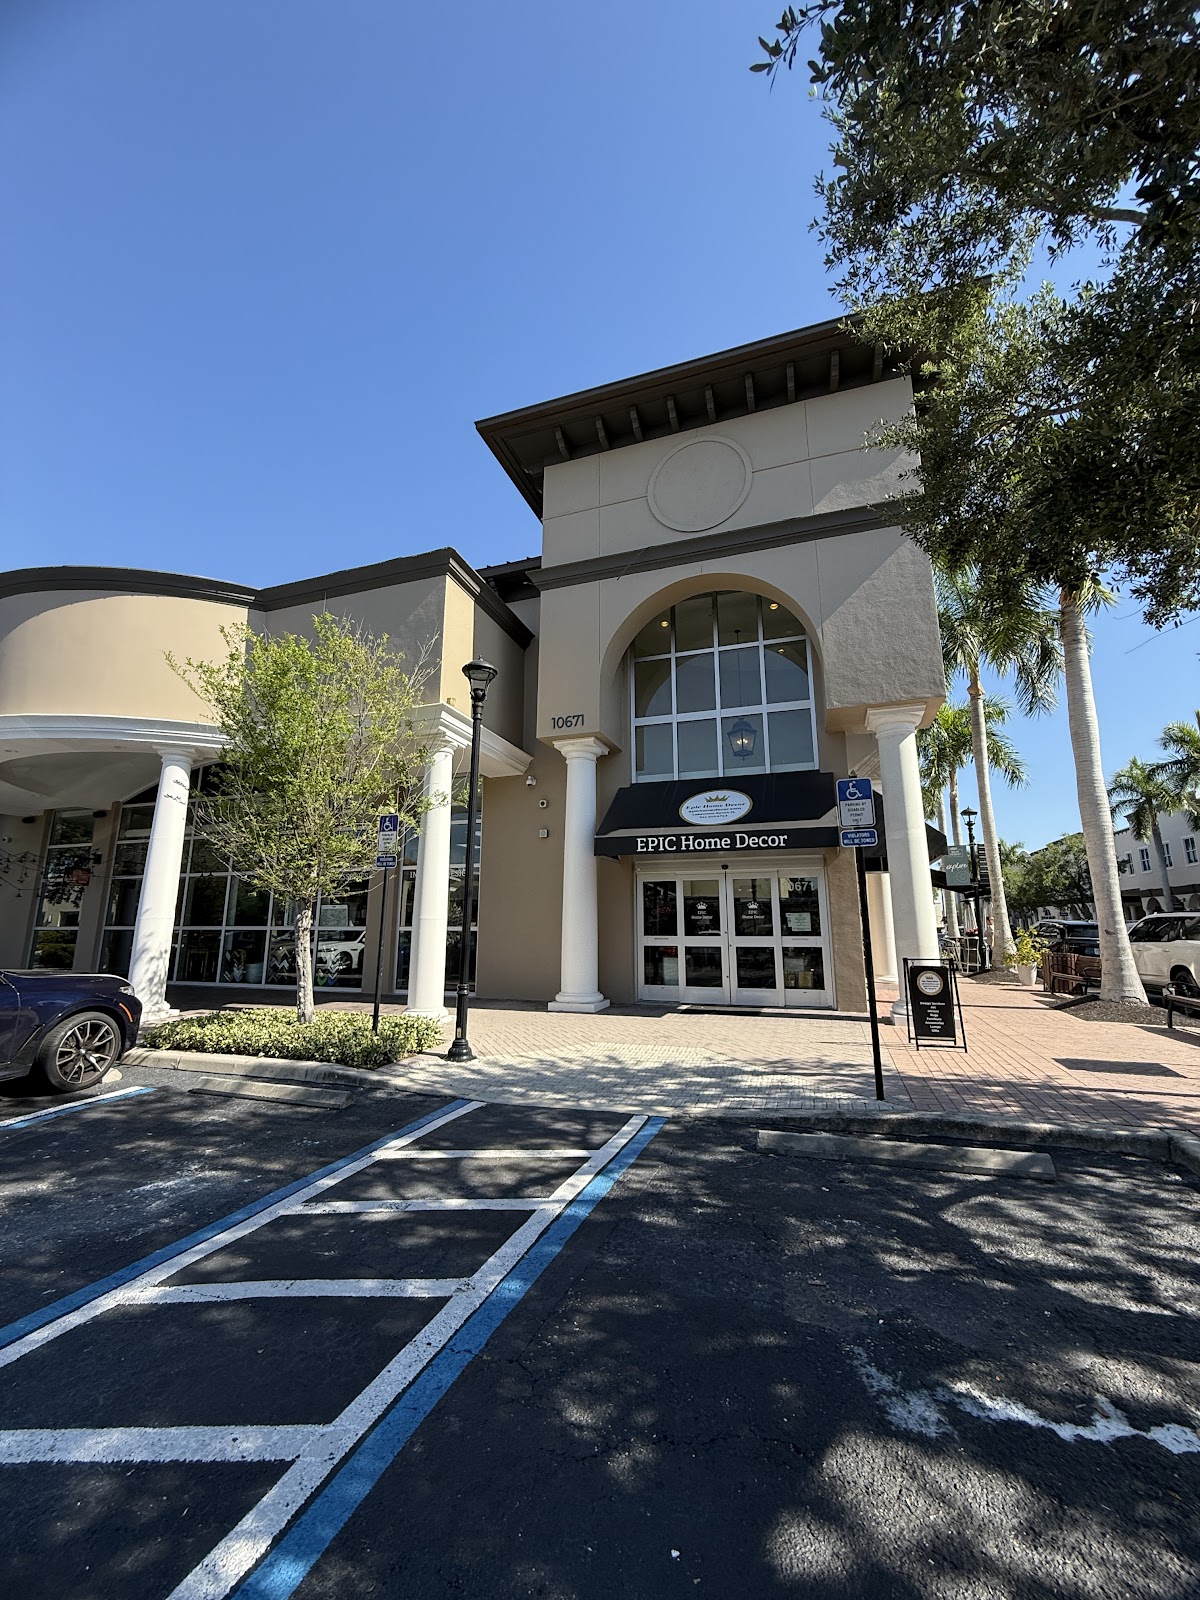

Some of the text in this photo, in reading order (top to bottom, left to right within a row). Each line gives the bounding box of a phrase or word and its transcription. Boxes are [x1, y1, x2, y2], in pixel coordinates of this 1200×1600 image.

[551, 714, 585, 729] 10671
[636, 834, 788, 852] EPIC Home Decor
[946, 862, 968, 872] explore
